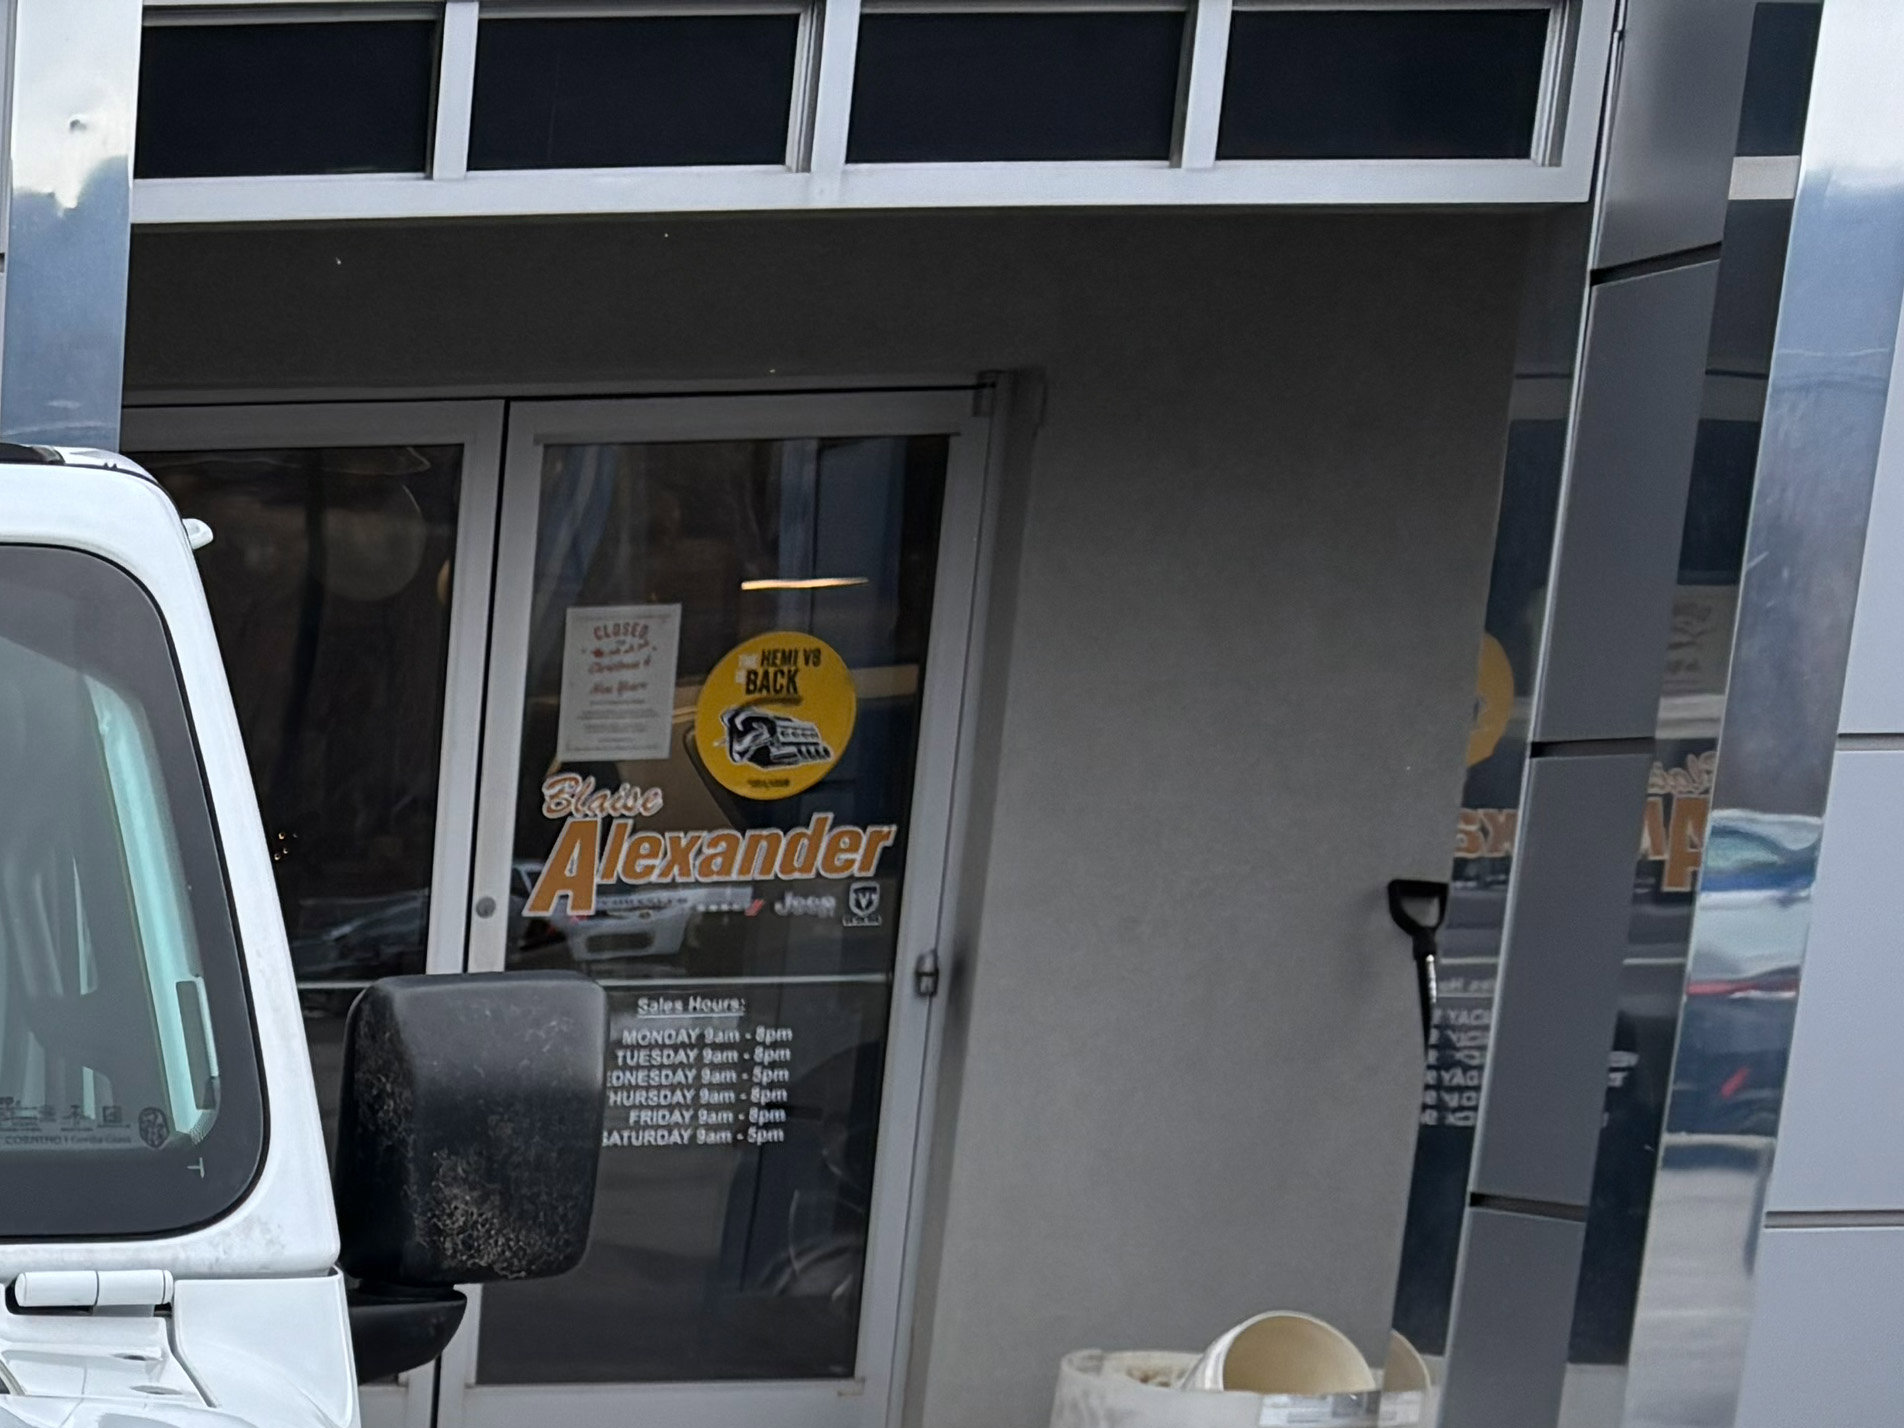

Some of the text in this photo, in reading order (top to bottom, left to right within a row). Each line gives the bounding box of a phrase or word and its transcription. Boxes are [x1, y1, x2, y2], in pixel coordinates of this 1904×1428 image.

[745, 669, 799, 695] BACK
[542, 772, 664, 819] Blaise
[522, 812, 897, 916] Alexander
[637, 995, 745, 1015] Sales Hours:
[622, 1027, 700, 1046] MONDAY
[704, 1028, 740, 1043] 9am
[616, 1047, 698, 1066] TUESDAY
[702, 1047, 738, 1063] 9am
[701, 1067, 737, 1084] 9am
[699, 1088, 735, 1104] 9am
[629, 1108, 694, 1126] FRIDAY
[698, 1108, 734, 1124] 9am
[696, 1128, 732, 1145] 9am
